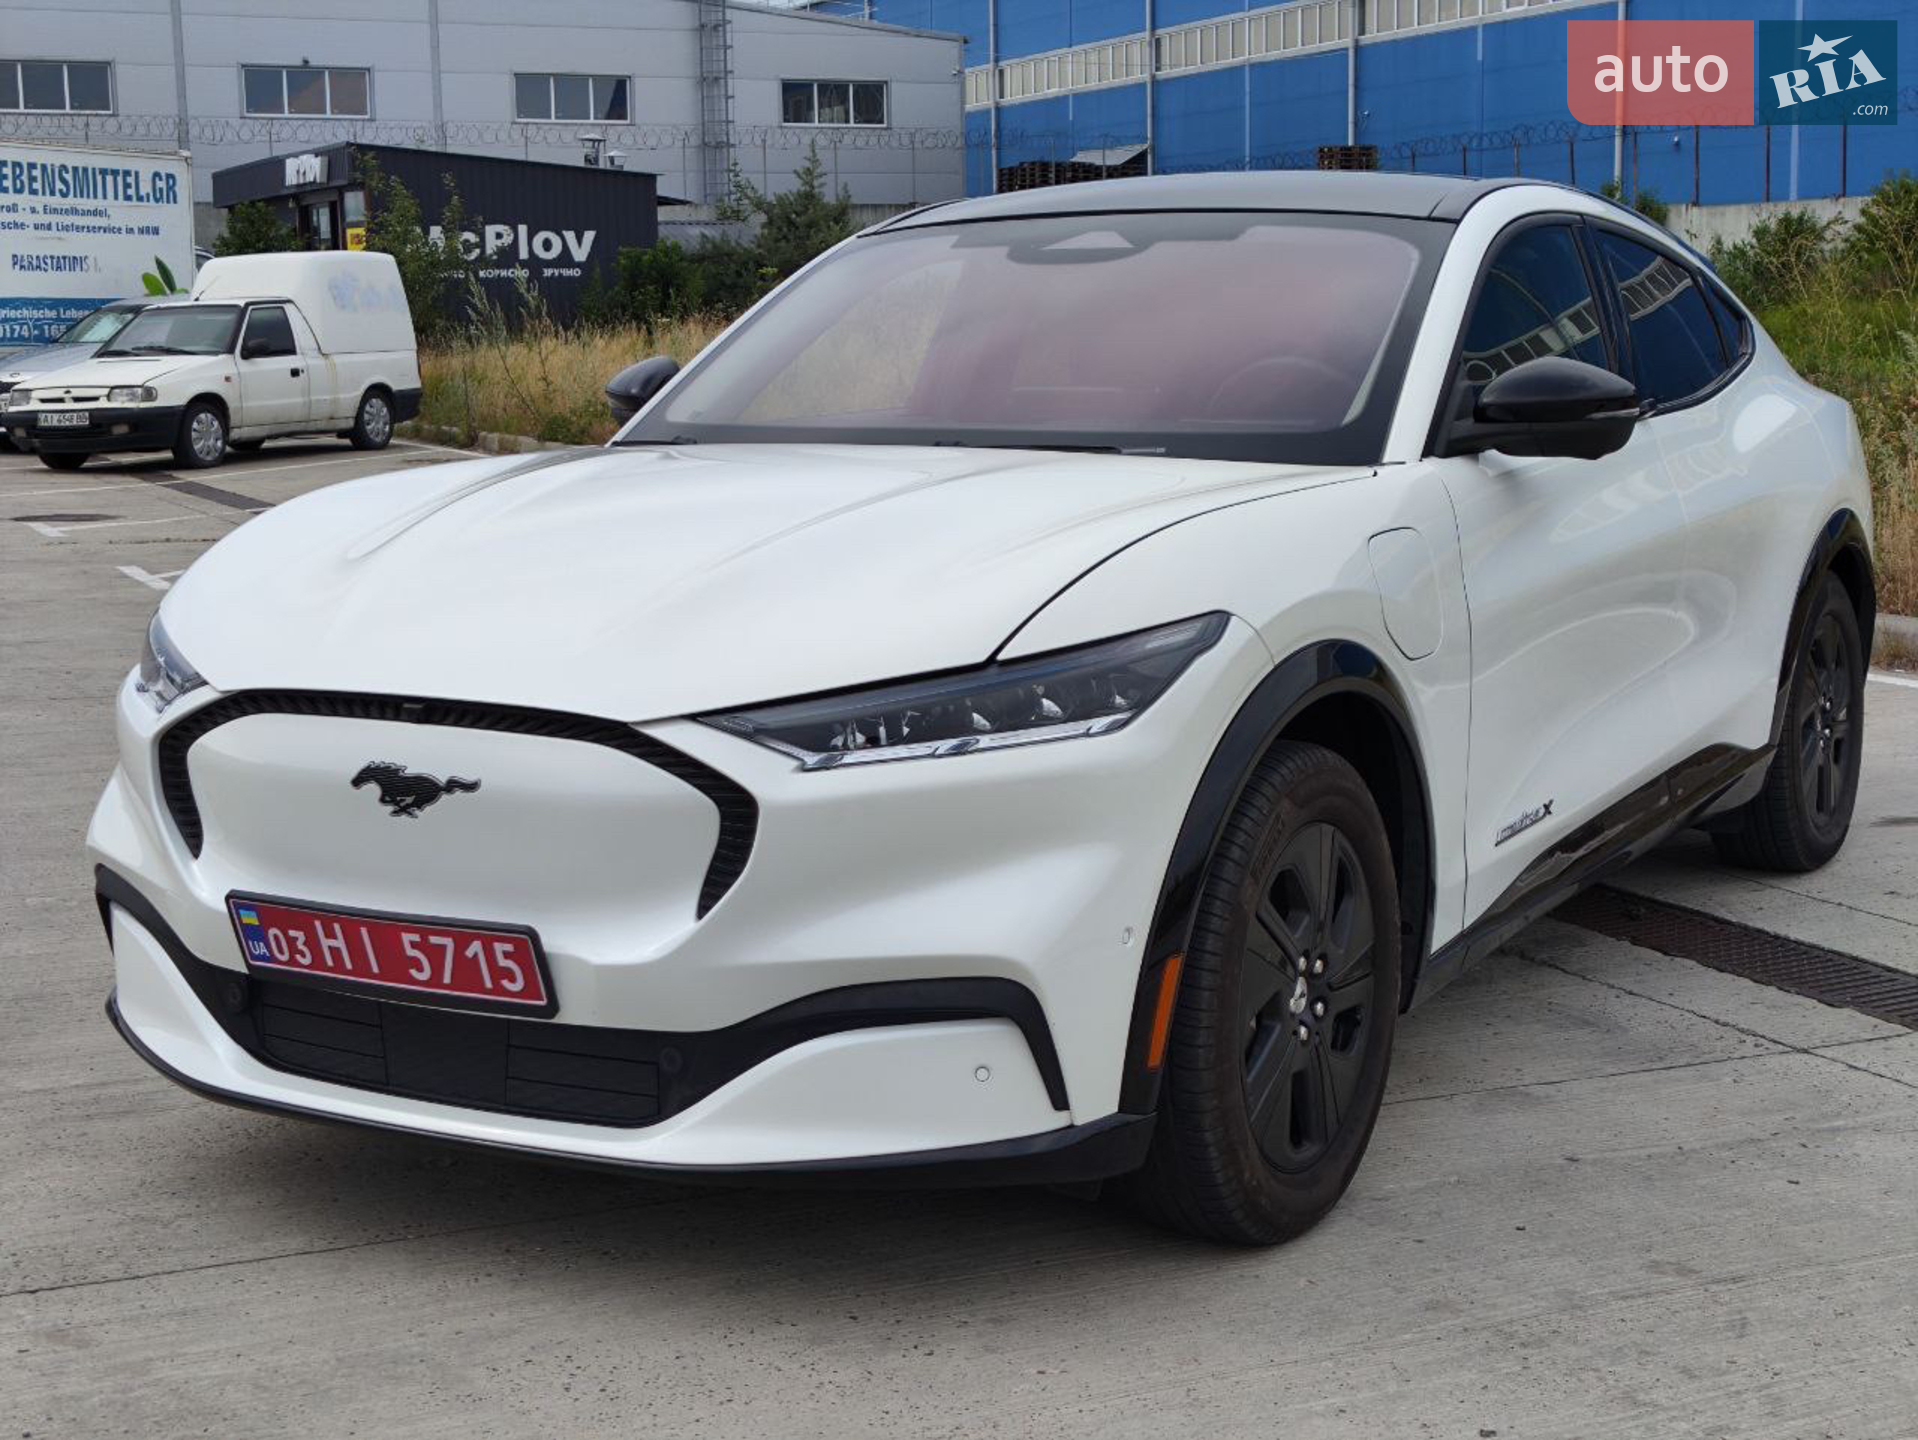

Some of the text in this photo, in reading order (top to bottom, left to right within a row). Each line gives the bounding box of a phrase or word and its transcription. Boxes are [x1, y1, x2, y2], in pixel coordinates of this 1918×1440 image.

[0, 160, 178, 205] EBENSMITTEL.GR
[43, 205, 110, 219] Einzelhandel,
[34, 222, 51, 231] und
[56, 222, 122, 234] Lieferservice
[125, 224, 135, 234] in
[137, 225, 160, 236] NRW
[542, 267, 582, 277] ЗРУЧНО
[0, 307, 57, 319] riechische
[249, 940, 270, 957] UA
[401, 932, 525, 993] 5715
